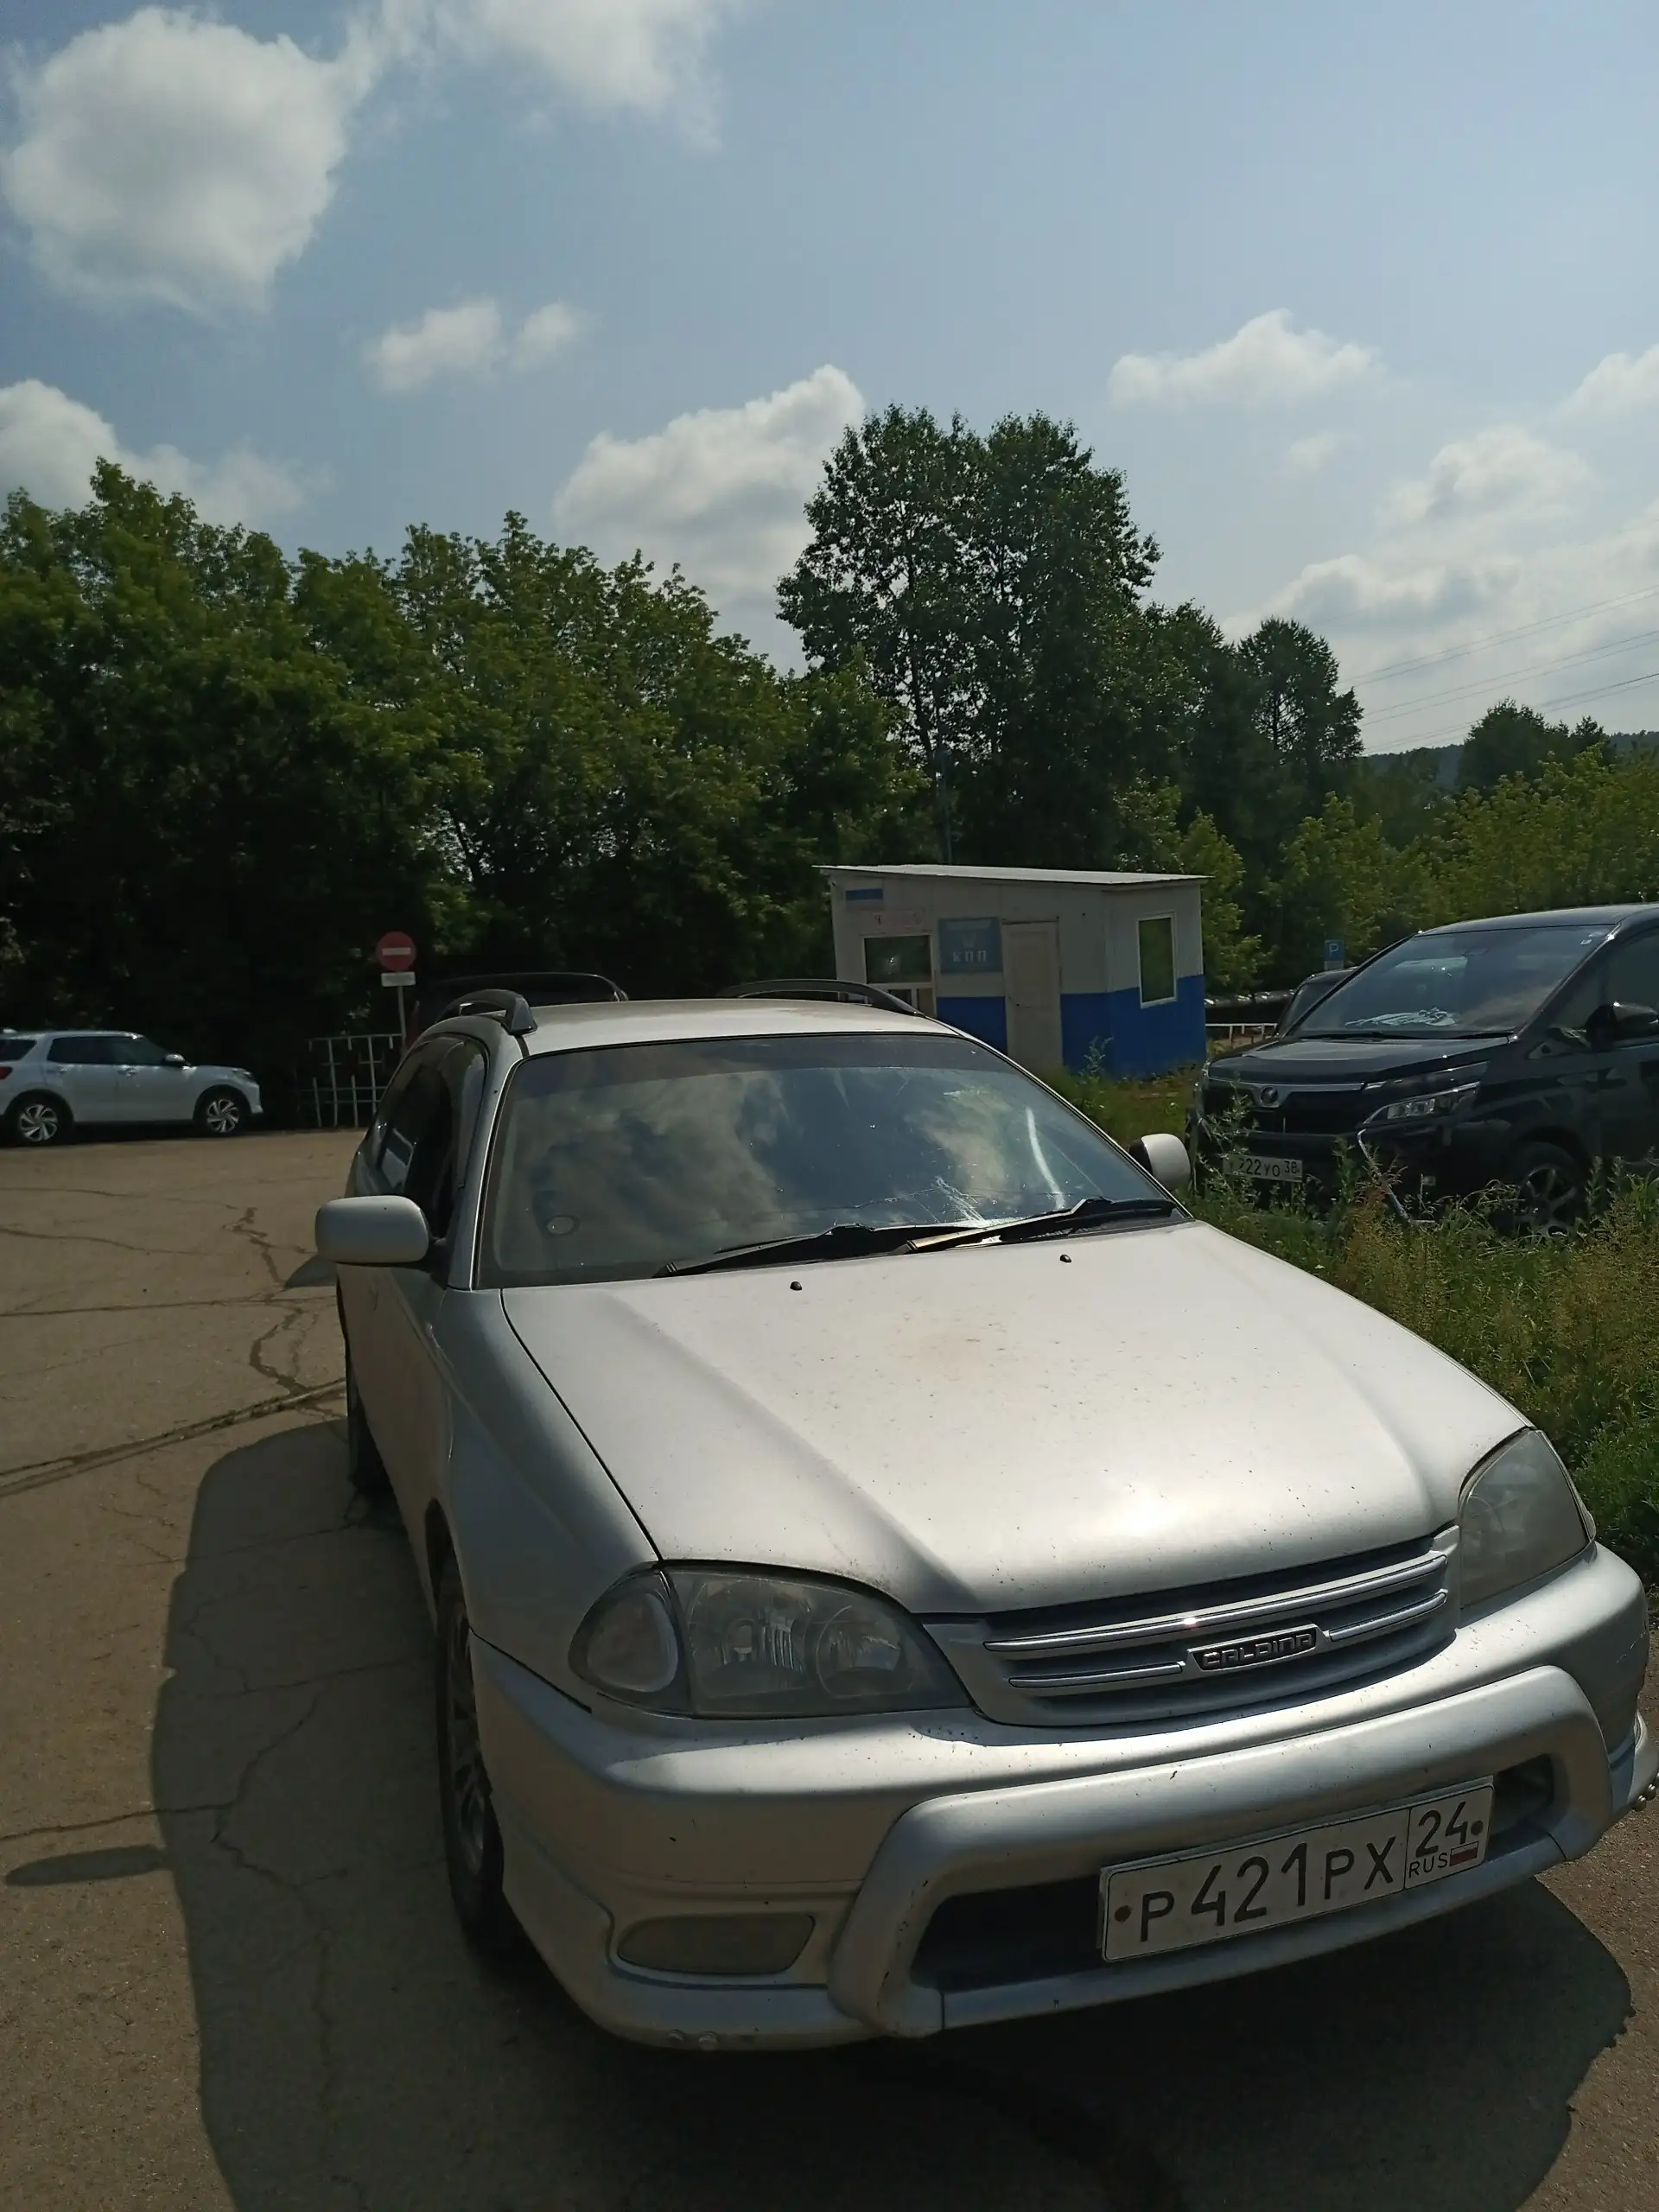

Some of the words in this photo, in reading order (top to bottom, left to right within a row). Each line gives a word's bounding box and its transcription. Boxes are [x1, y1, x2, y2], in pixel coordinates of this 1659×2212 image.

[953, 950, 987, 963] КПП
[1202, 1633, 1313, 1668] CALDINA
[1140, 1835, 1396, 1942] Р421РХ
[1414, 1801, 1468, 1858] 24
[1408, 1851, 1448, 1879] RUS
